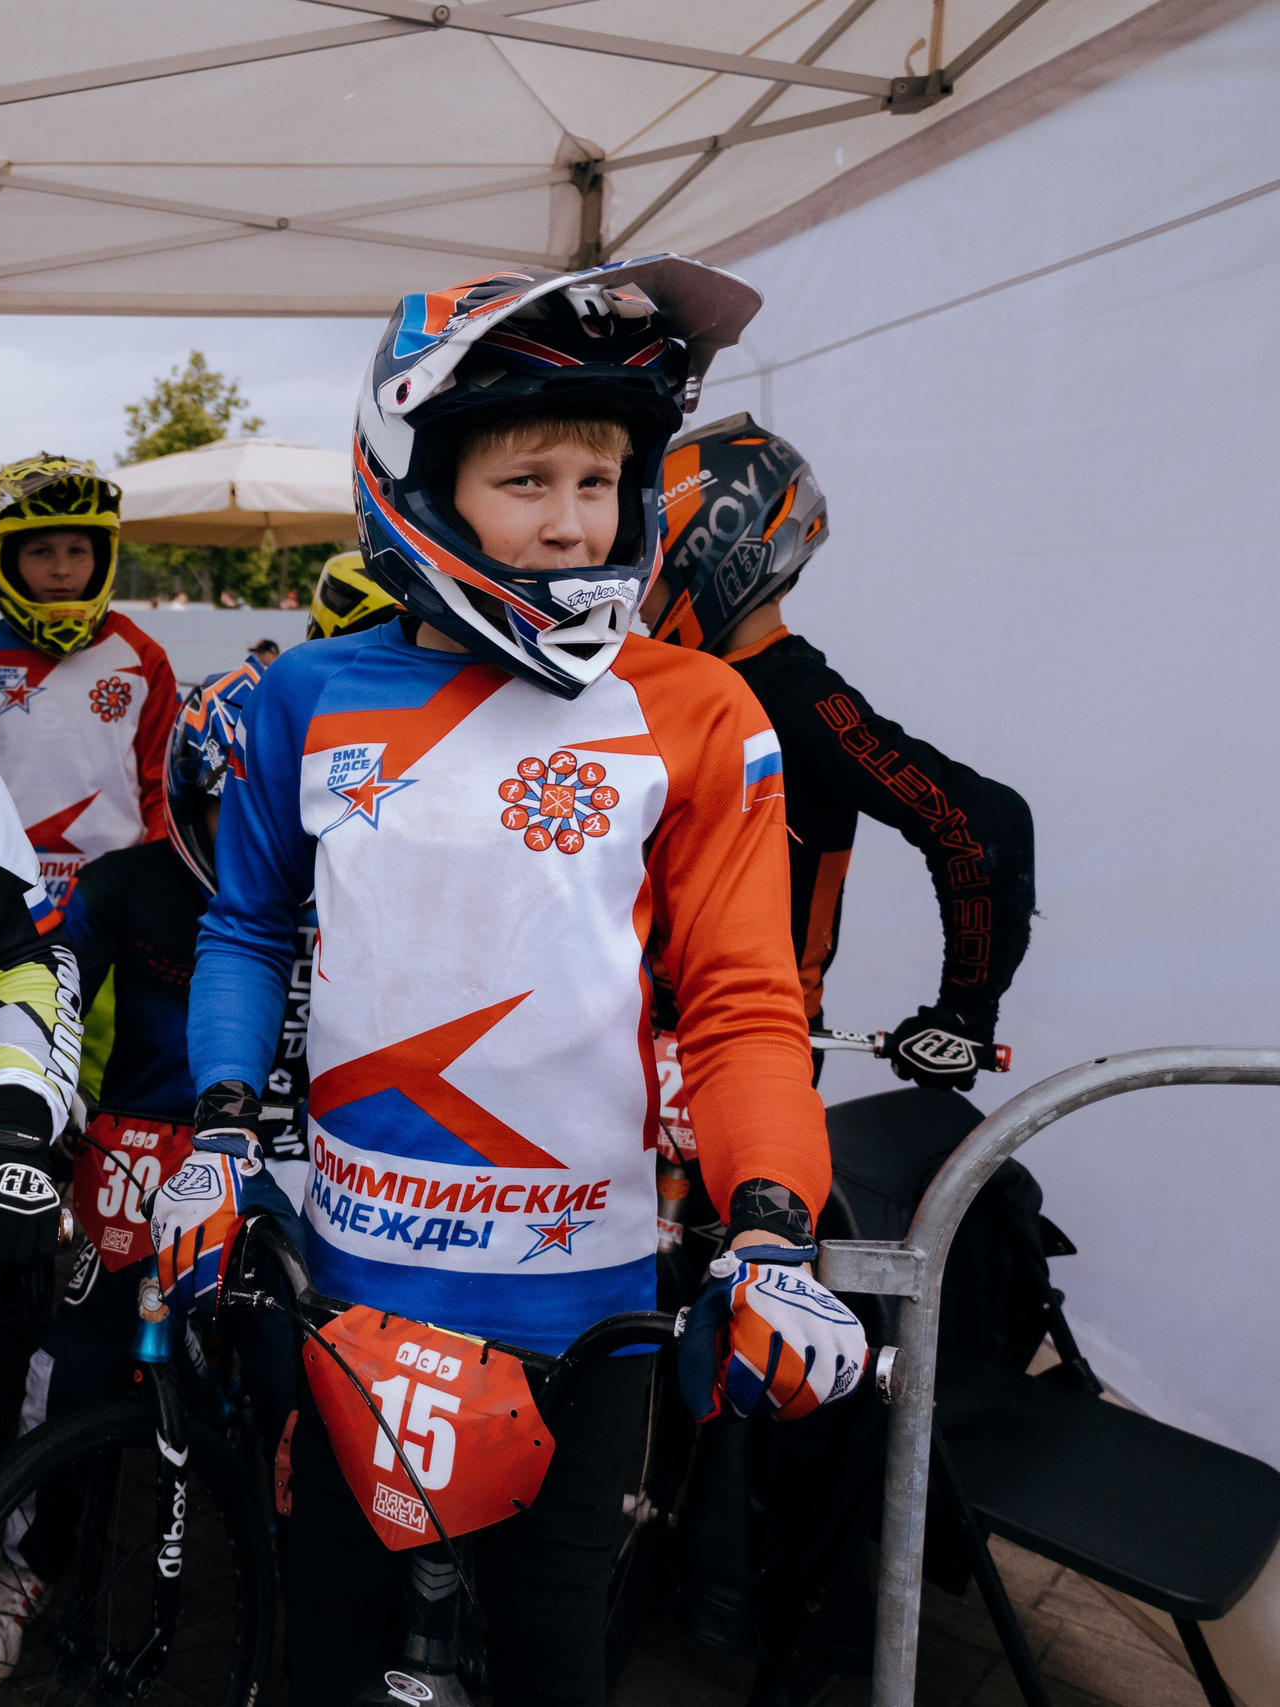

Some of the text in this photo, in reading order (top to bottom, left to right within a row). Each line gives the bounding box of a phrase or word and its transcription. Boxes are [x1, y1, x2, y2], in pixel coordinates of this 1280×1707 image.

[658, 468, 713, 507] nvoke
[568, 589, 593, 608] Troy
[593, 585, 617, 600] Lee
[329, 759, 371, 775] RACE
[332, 747, 369, 763] BMX
[326, 773, 348, 787] ON
[816, 693, 992, 988] LOS RAKETOS
[656, 1060, 690, 1121] 2
[122, 1133, 155, 1147] ЛСР
[97, 1150, 161, 1224] 30
[313, 1134, 611, 1214] ОЛИМПИЙСКИЕ
[310, 1167, 494, 1251] НАДЕЖДЫ
[104, 1227, 131, 1243] ПАМП
[397, 1347, 456, 1379] ЛСР
[371, 1374, 461, 1490] 15
[163, 1480, 187, 1540] box
[376, 1500, 423, 1528] ДЖЕМ
[378, 1488, 426, 1515] ПАМП
